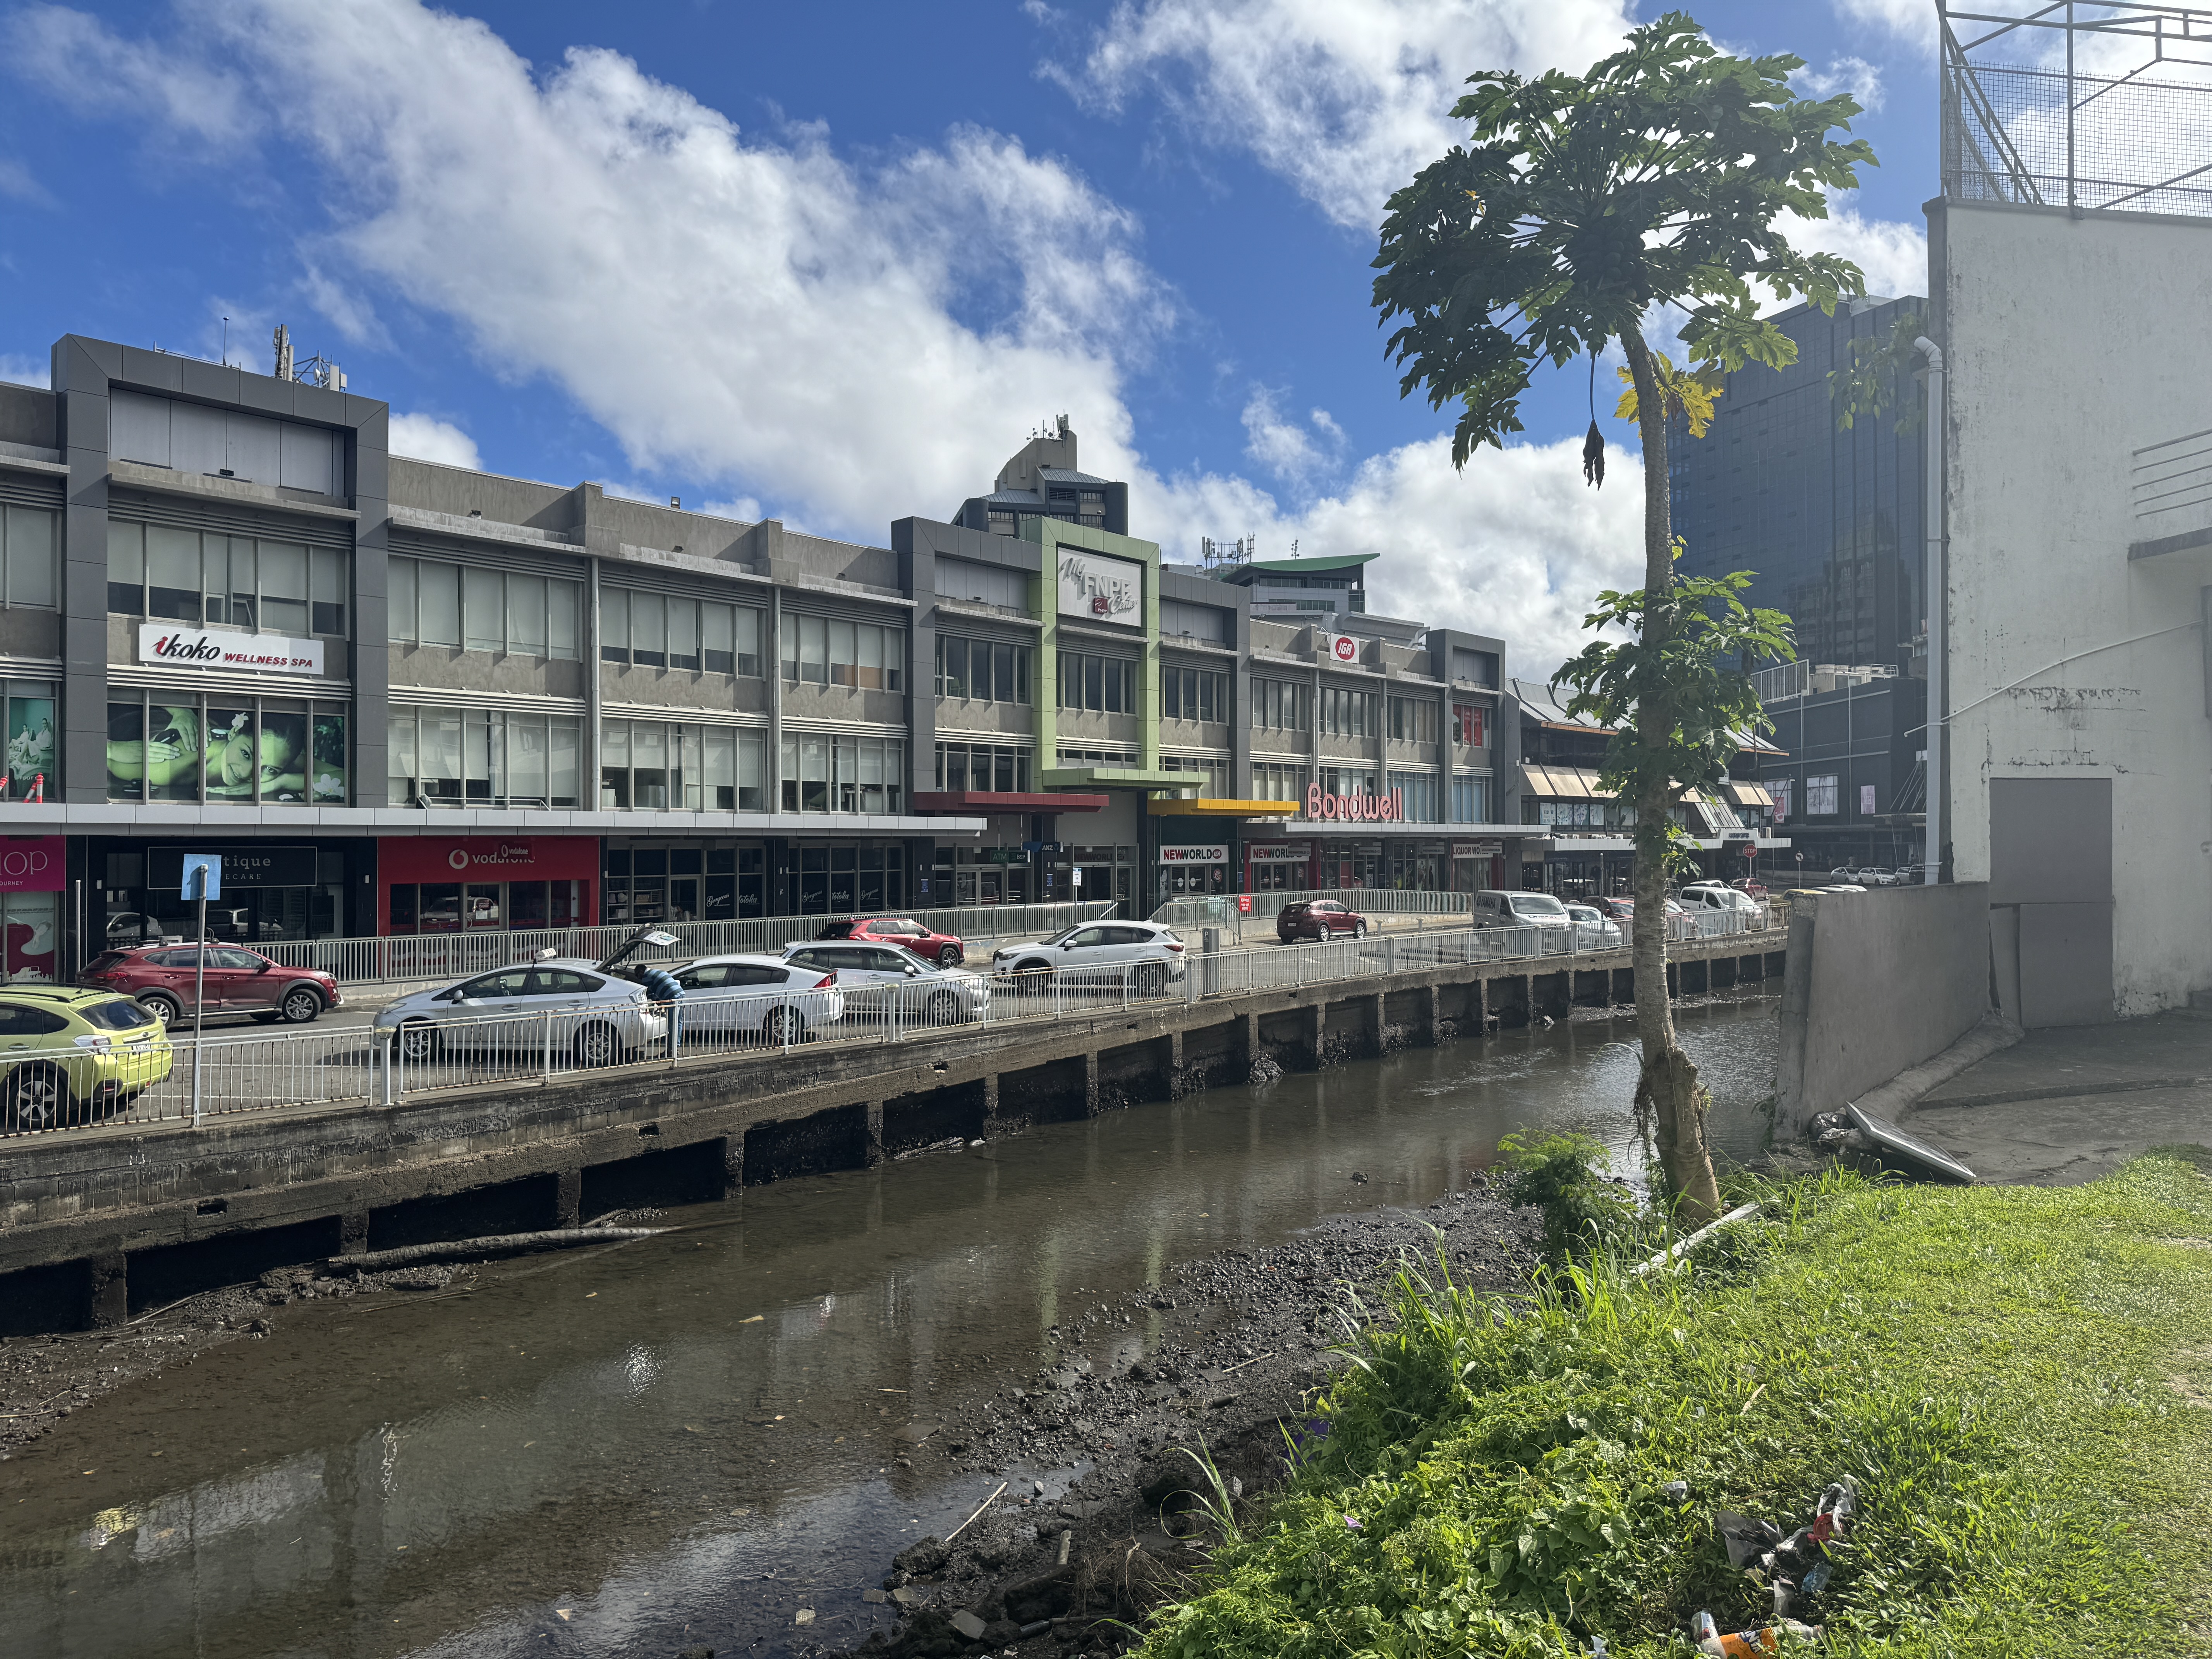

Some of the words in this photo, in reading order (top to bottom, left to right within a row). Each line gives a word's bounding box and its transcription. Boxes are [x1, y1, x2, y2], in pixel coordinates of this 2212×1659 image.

[1084, 572, 1131, 600] FNPF
[1338, 642, 1352, 655] IGA
[225, 653, 288, 666] WELLNESS
[291, 658, 313, 668] SPA
[1306, 782, 1402, 820] Bondwell
[223, 855, 271, 869] tique
[1481, 896, 1496, 910] YAMAHA
